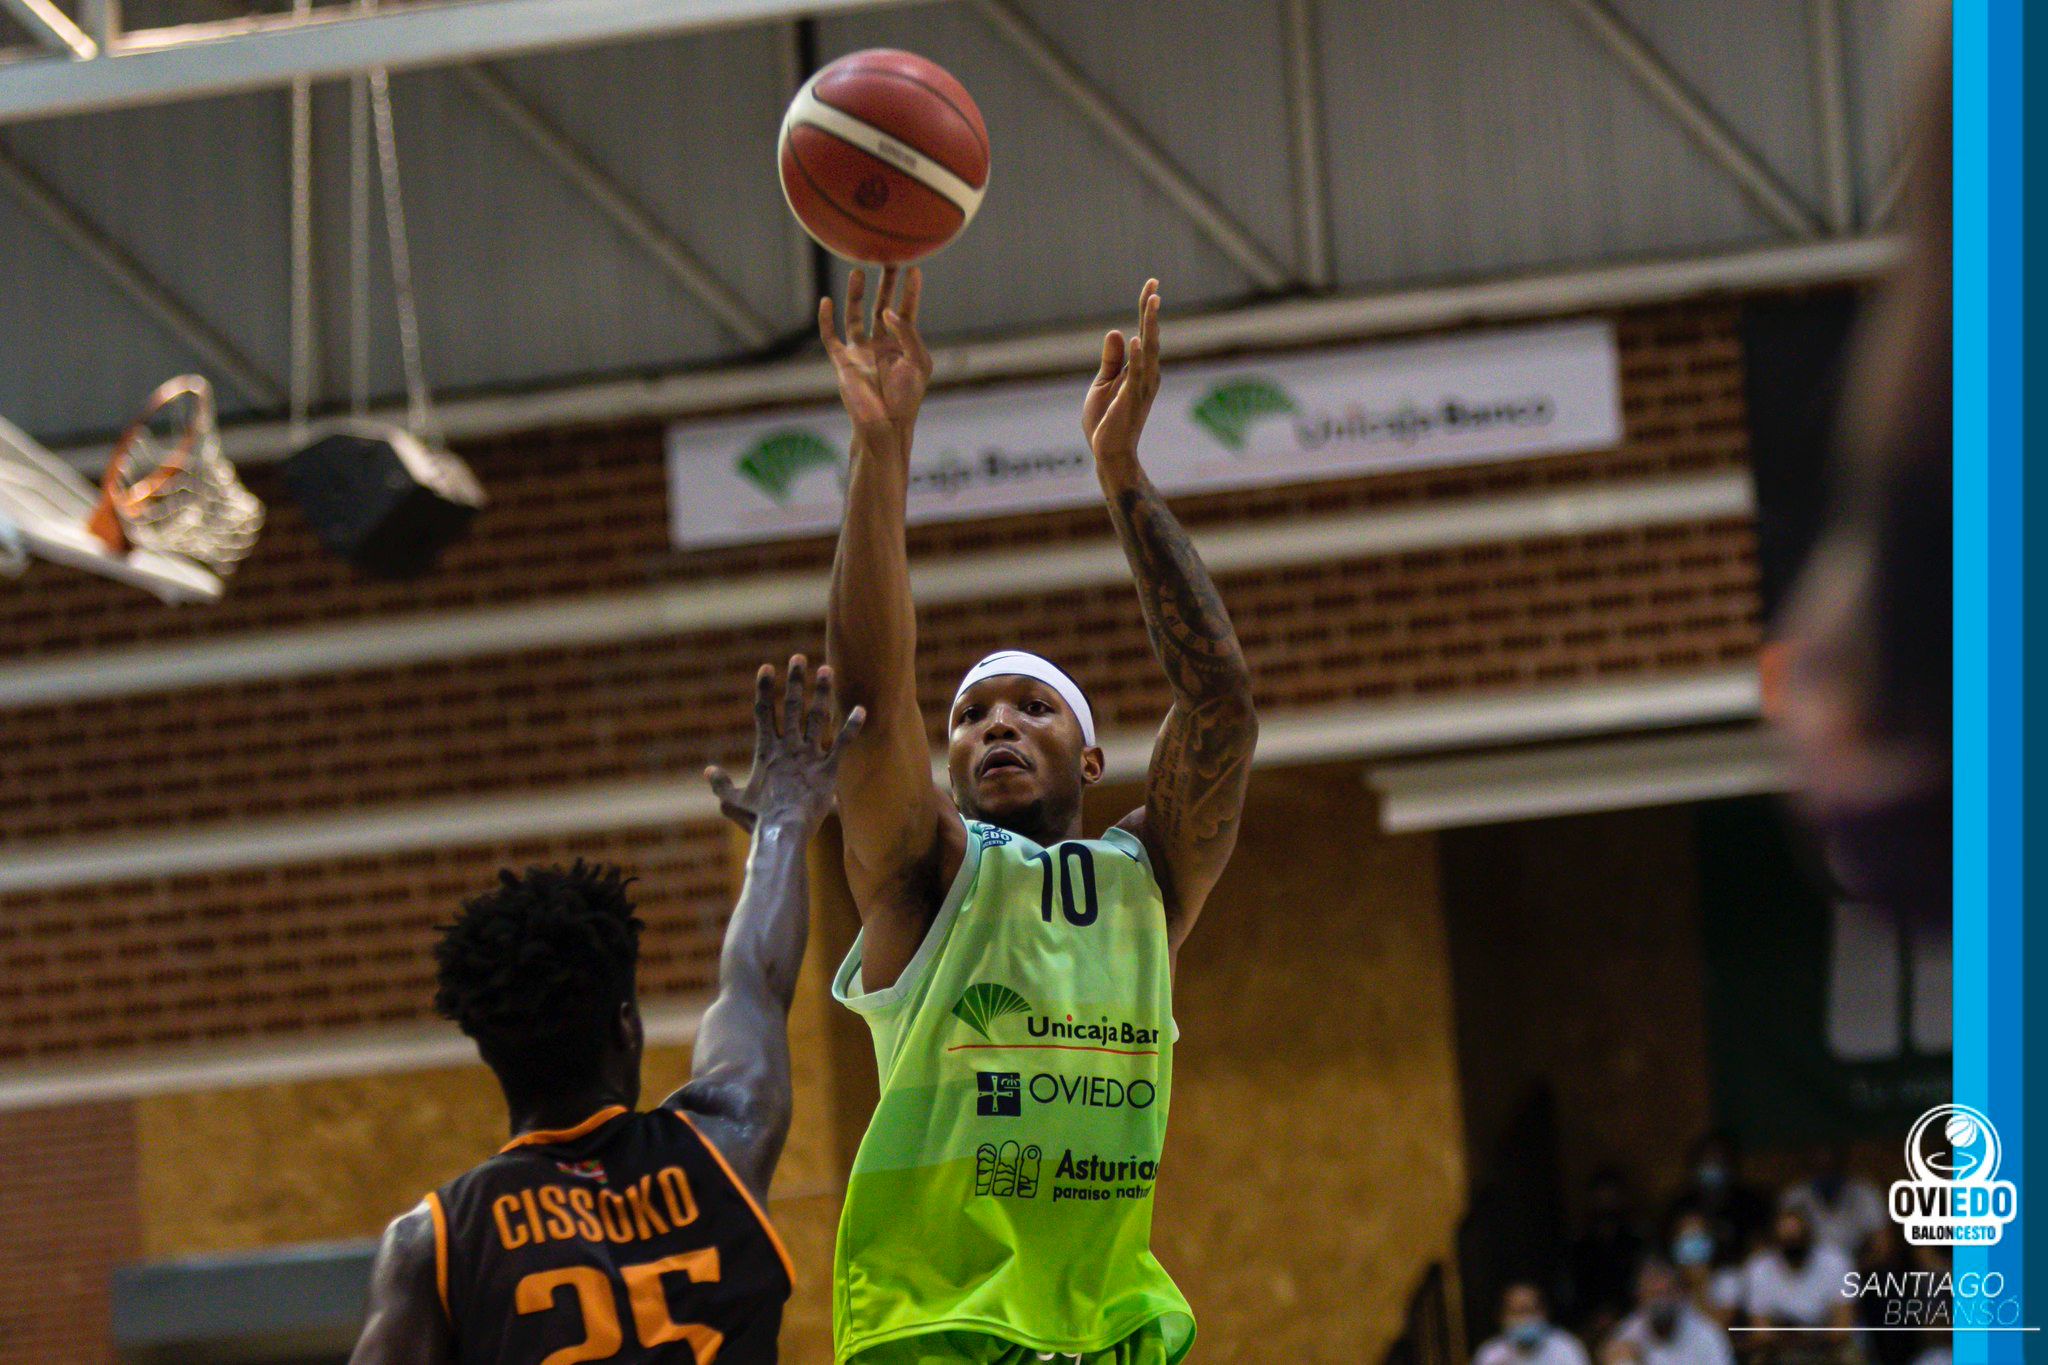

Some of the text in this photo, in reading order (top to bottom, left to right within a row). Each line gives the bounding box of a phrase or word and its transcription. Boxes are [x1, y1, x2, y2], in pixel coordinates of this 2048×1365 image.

[1026, 842, 1099, 927] 10
[1029, 1073, 1156, 1109] OVIEDO
[492, 1166, 699, 1250] CISSOKO
[1053, 1185, 1111, 1202] paraiso
[515, 1247, 724, 1365] 25
